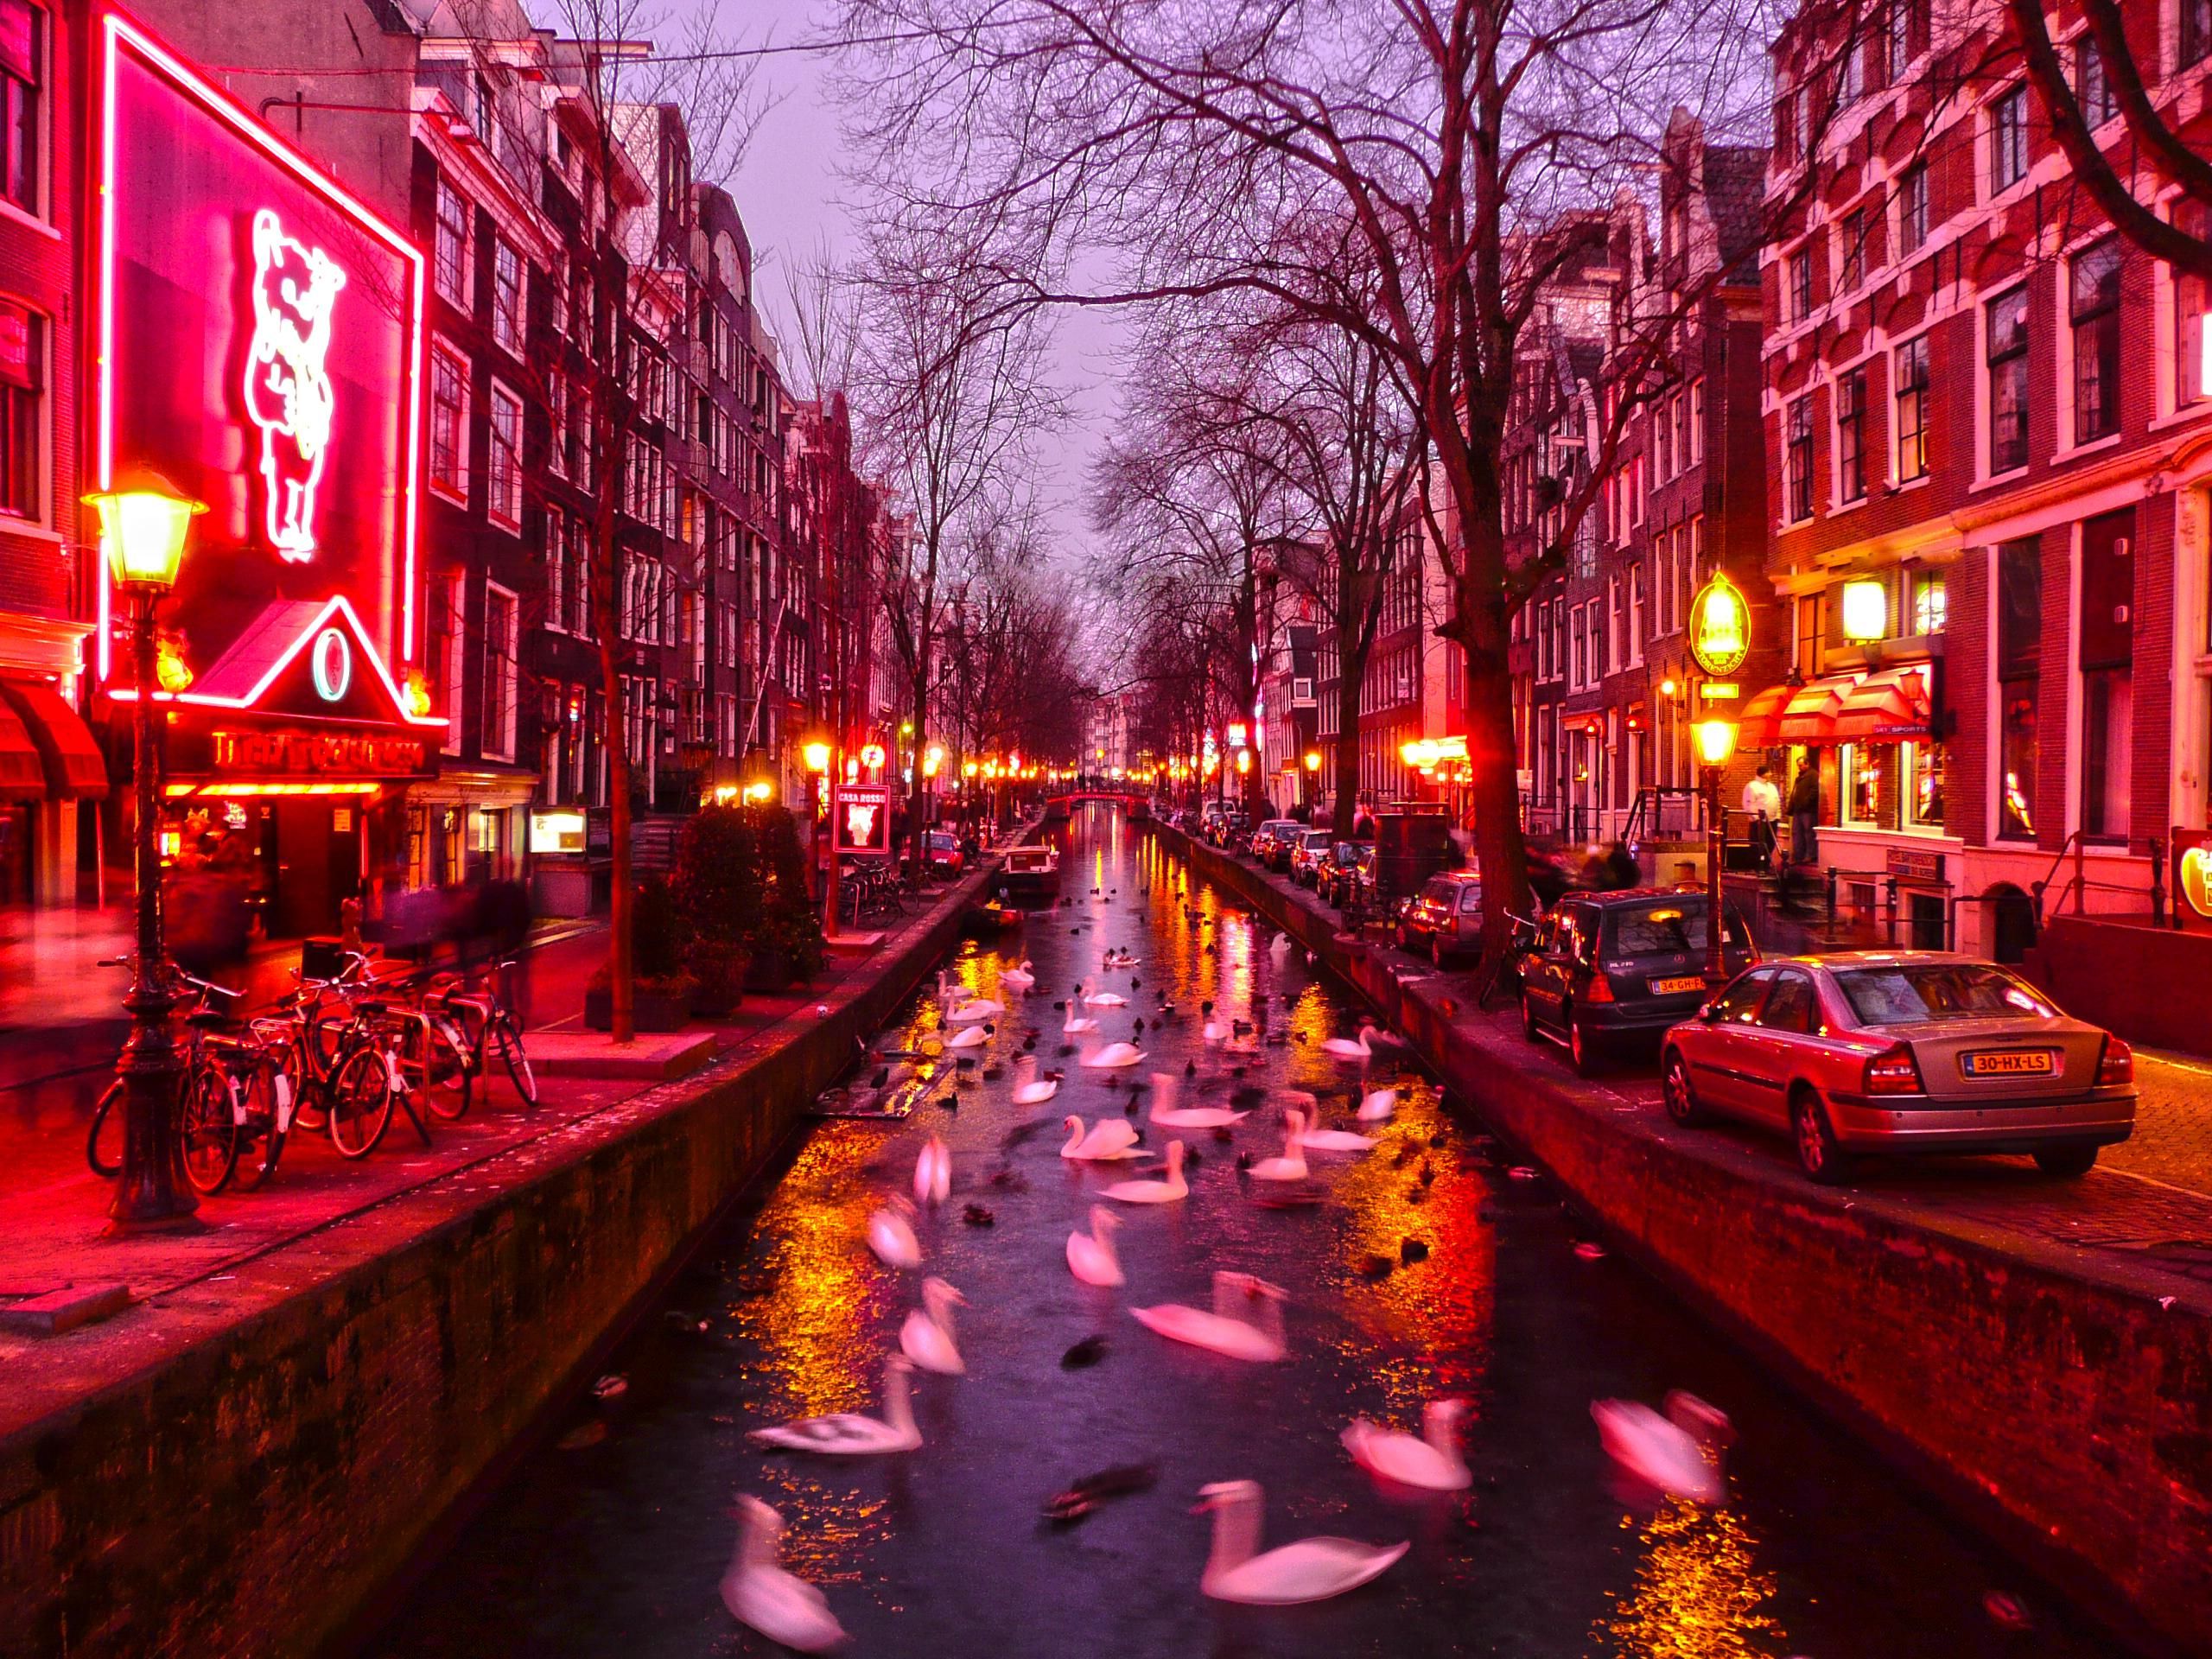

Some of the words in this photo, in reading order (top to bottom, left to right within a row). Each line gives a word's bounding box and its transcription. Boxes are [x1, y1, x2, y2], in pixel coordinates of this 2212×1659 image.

[838, 793, 859, 803] CASA
[860, 794, 886, 804] ROSSO
[1978, 1056, 2045, 1071] 30-HX-LS
